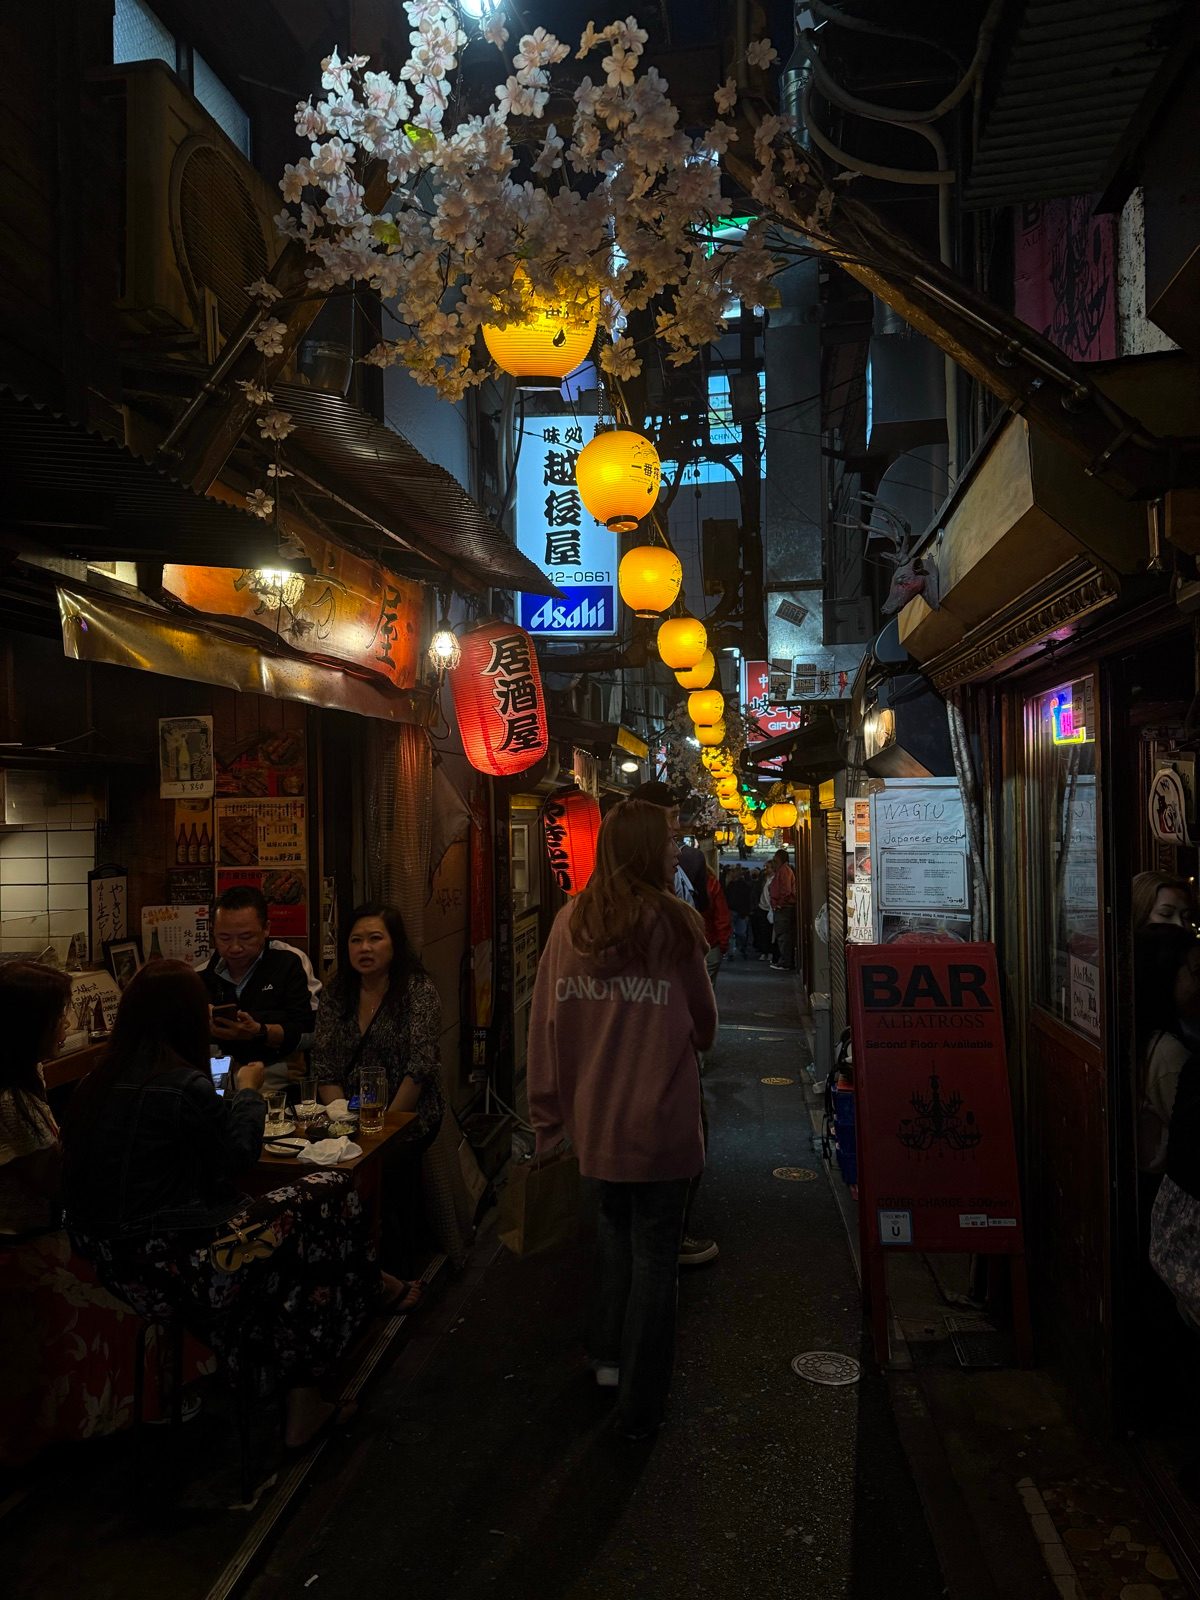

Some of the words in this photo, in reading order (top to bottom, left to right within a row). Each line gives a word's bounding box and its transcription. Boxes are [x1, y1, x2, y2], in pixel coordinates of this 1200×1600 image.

[543, 449, 582, 566] 越後屋
[547, 571, 610, 583] 42-0661
[530, 597, 605, 629] Asahi
[485, 633, 543, 753] 居酒屋
[767, 720, 801, 732] GIFUY
[883, 803, 945, 820] WAGYU
[884, 830, 932, 847] Japanese
[936, 829, 965, 843] beef
[852, 928, 873, 940] JAPA
[861, 964, 993, 1008] BAR
[878, 1015, 985, 1029] ALBATROSS
[865, 1039, 907, 1049] Second
[910, 1039, 938, 1049] Floor
[942, 1039, 994, 1049] Available
[918, 1198, 963, 1208] CHARGE
